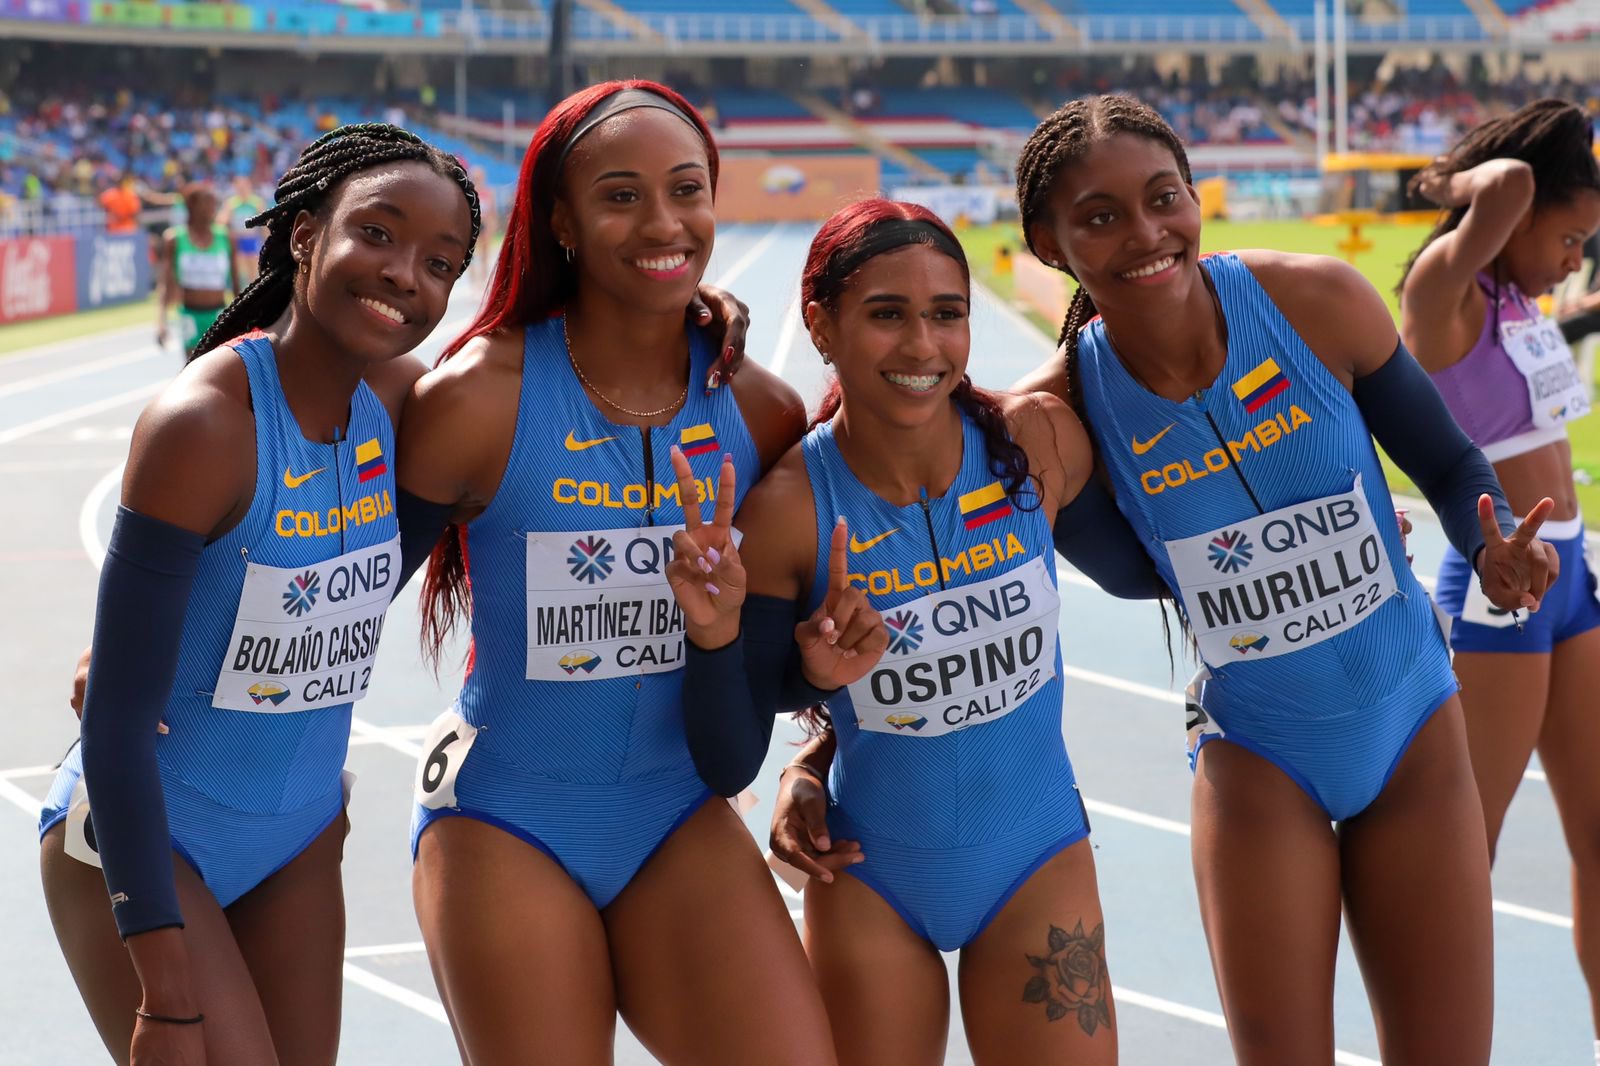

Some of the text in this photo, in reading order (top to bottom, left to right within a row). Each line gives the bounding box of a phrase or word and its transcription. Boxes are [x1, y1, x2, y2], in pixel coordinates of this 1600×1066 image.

[1140, 404, 1312, 495] COLOMBIA
[275, 490, 392, 537] COLOMBIA
[553, 476, 720, 509] COLOMBI
[1262, 499, 1360, 553] QNB
[327, 552, 391, 602] QNB
[1197, 534, 1380, 629] MURILLO
[537, 594, 687, 646] MARTÍNEZ IBA
[932, 580, 1031, 636] QNB
[1283, 582, 1382, 643] CALI 22
[233, 625, 324, 675] BOLAÑO
[616, 641, 682, 668] CALI
[871, 626, 1043, 705] OSPINO
[303, 671, 355, 703] CALI
[943, 668, 1041, 725] CALI 22
[422, 730, 459, 793] 6
